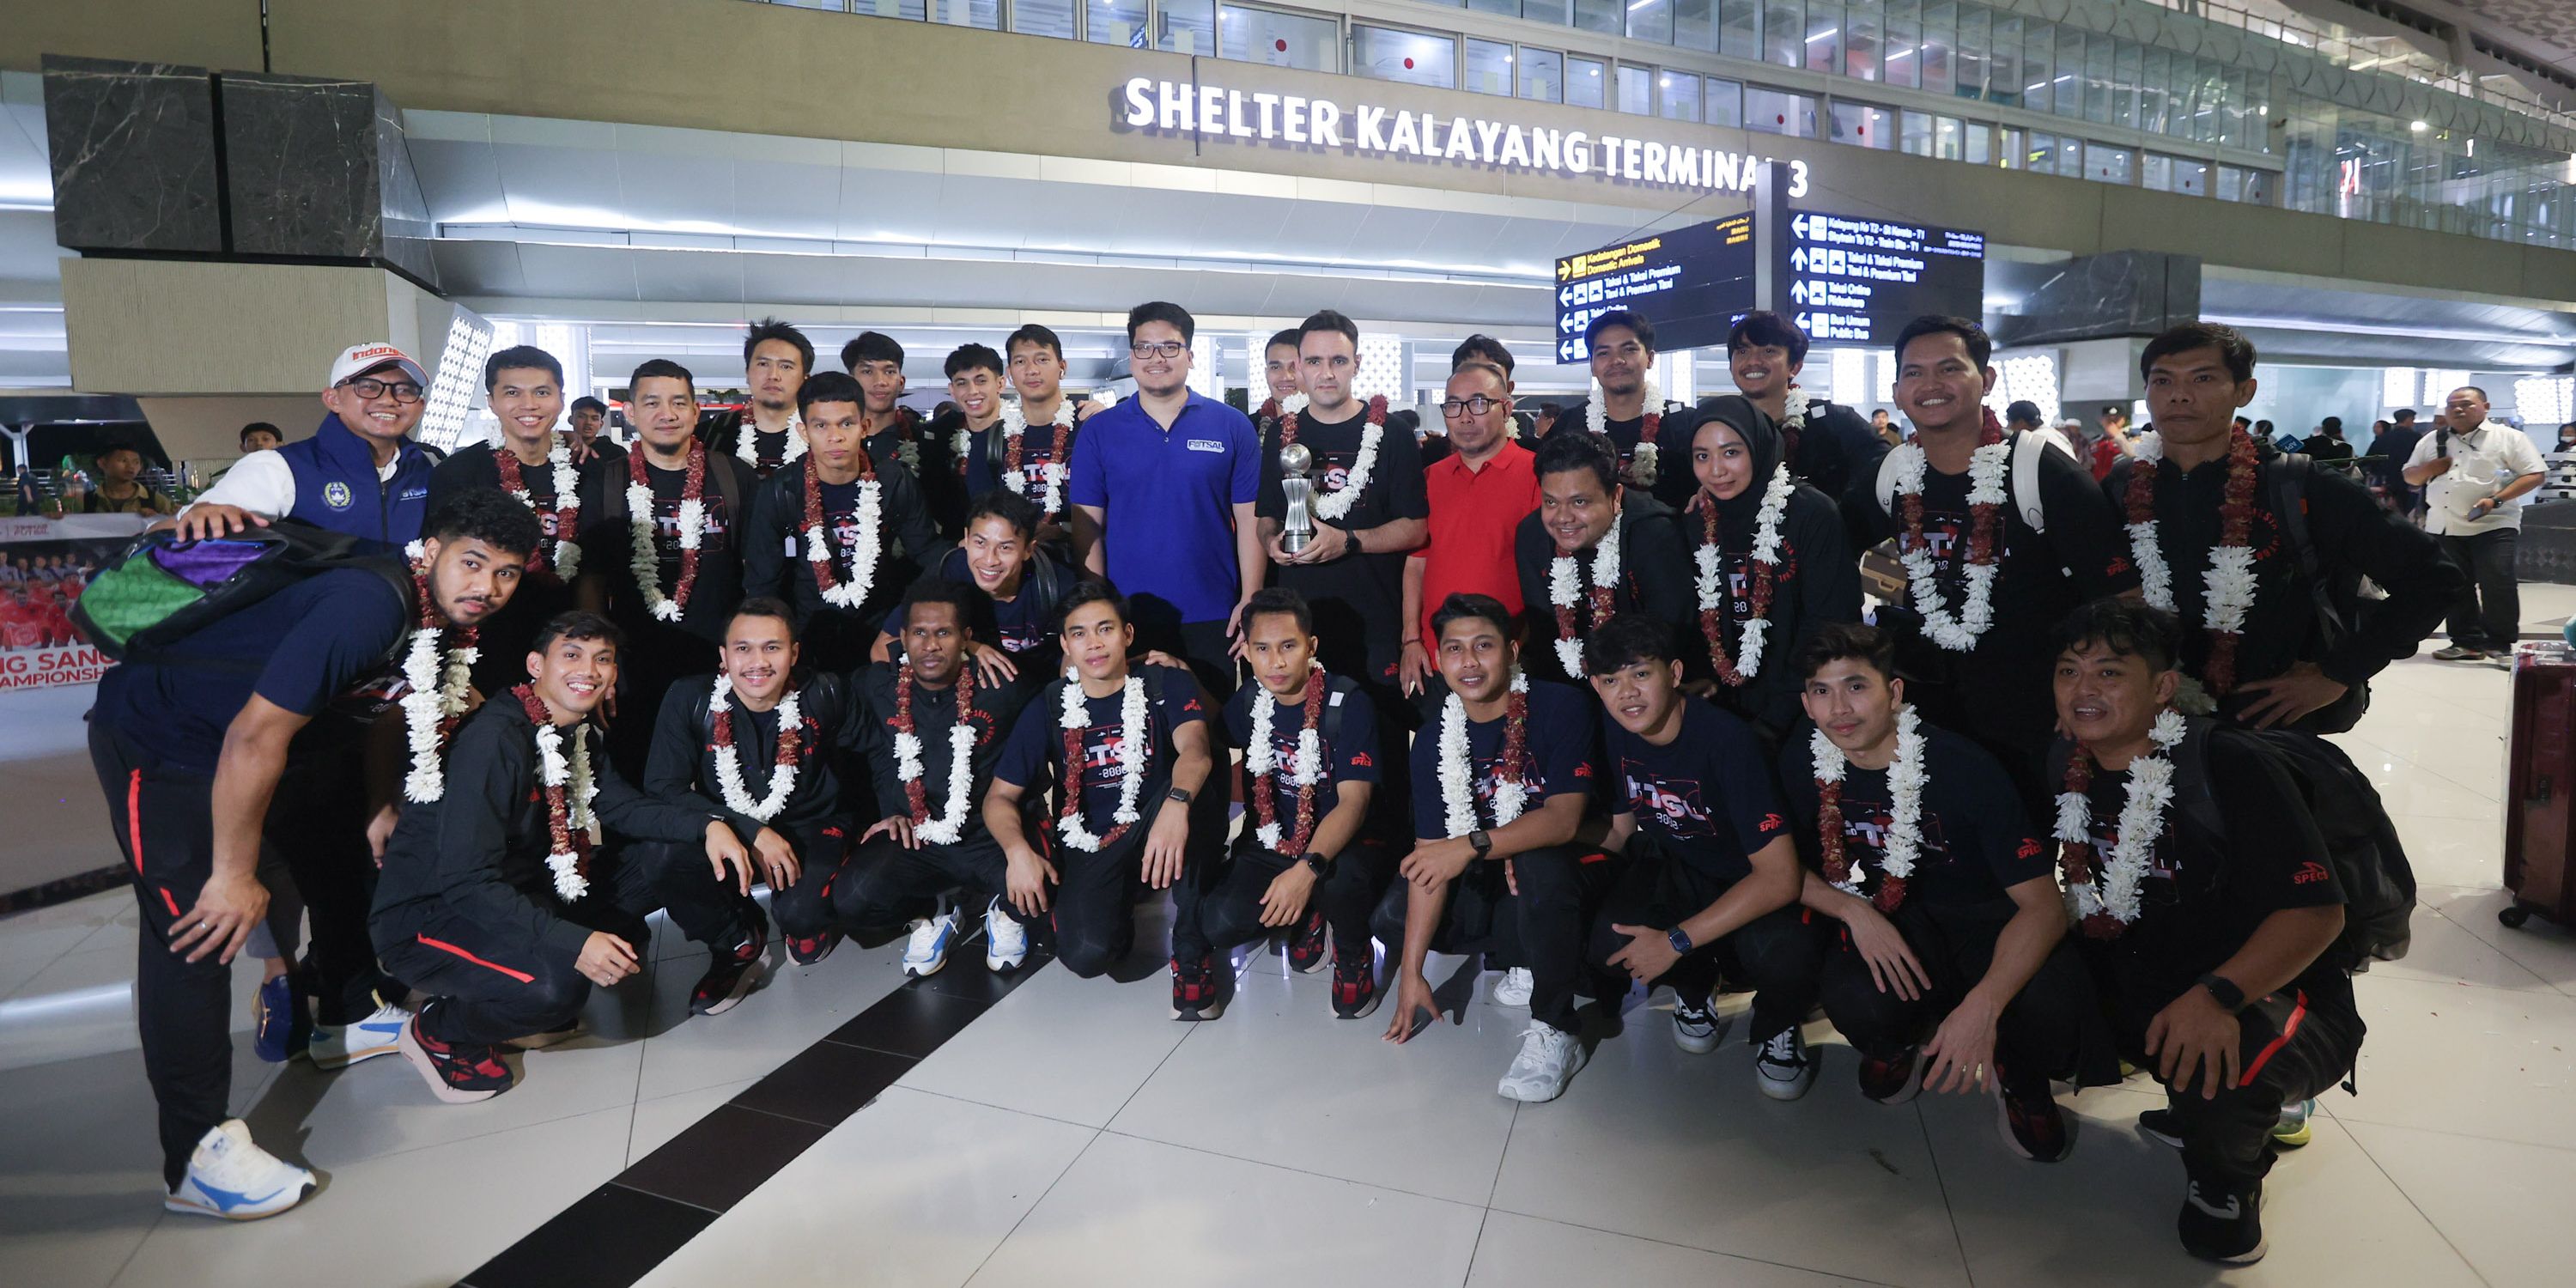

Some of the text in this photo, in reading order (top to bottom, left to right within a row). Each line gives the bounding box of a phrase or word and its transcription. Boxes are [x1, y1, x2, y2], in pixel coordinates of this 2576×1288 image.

[1126, 77, 1808, 198] SHELTER KALAYANG TERMINA 3
[1627, 238, 1662, 254] Domestik
[1587, 254, 1644, 276] Domestic Arrivals
[1867, 254, 1874, 264] &
[1604, 264, 1681, 288] Taksi & Taksi Premium
[1862, 266, 1869, 276] &
[1605, 287, 1619, 300] Taxi
[1619, 287, 1625, 297] &
[1626, 283, 1657, 296] Premium
